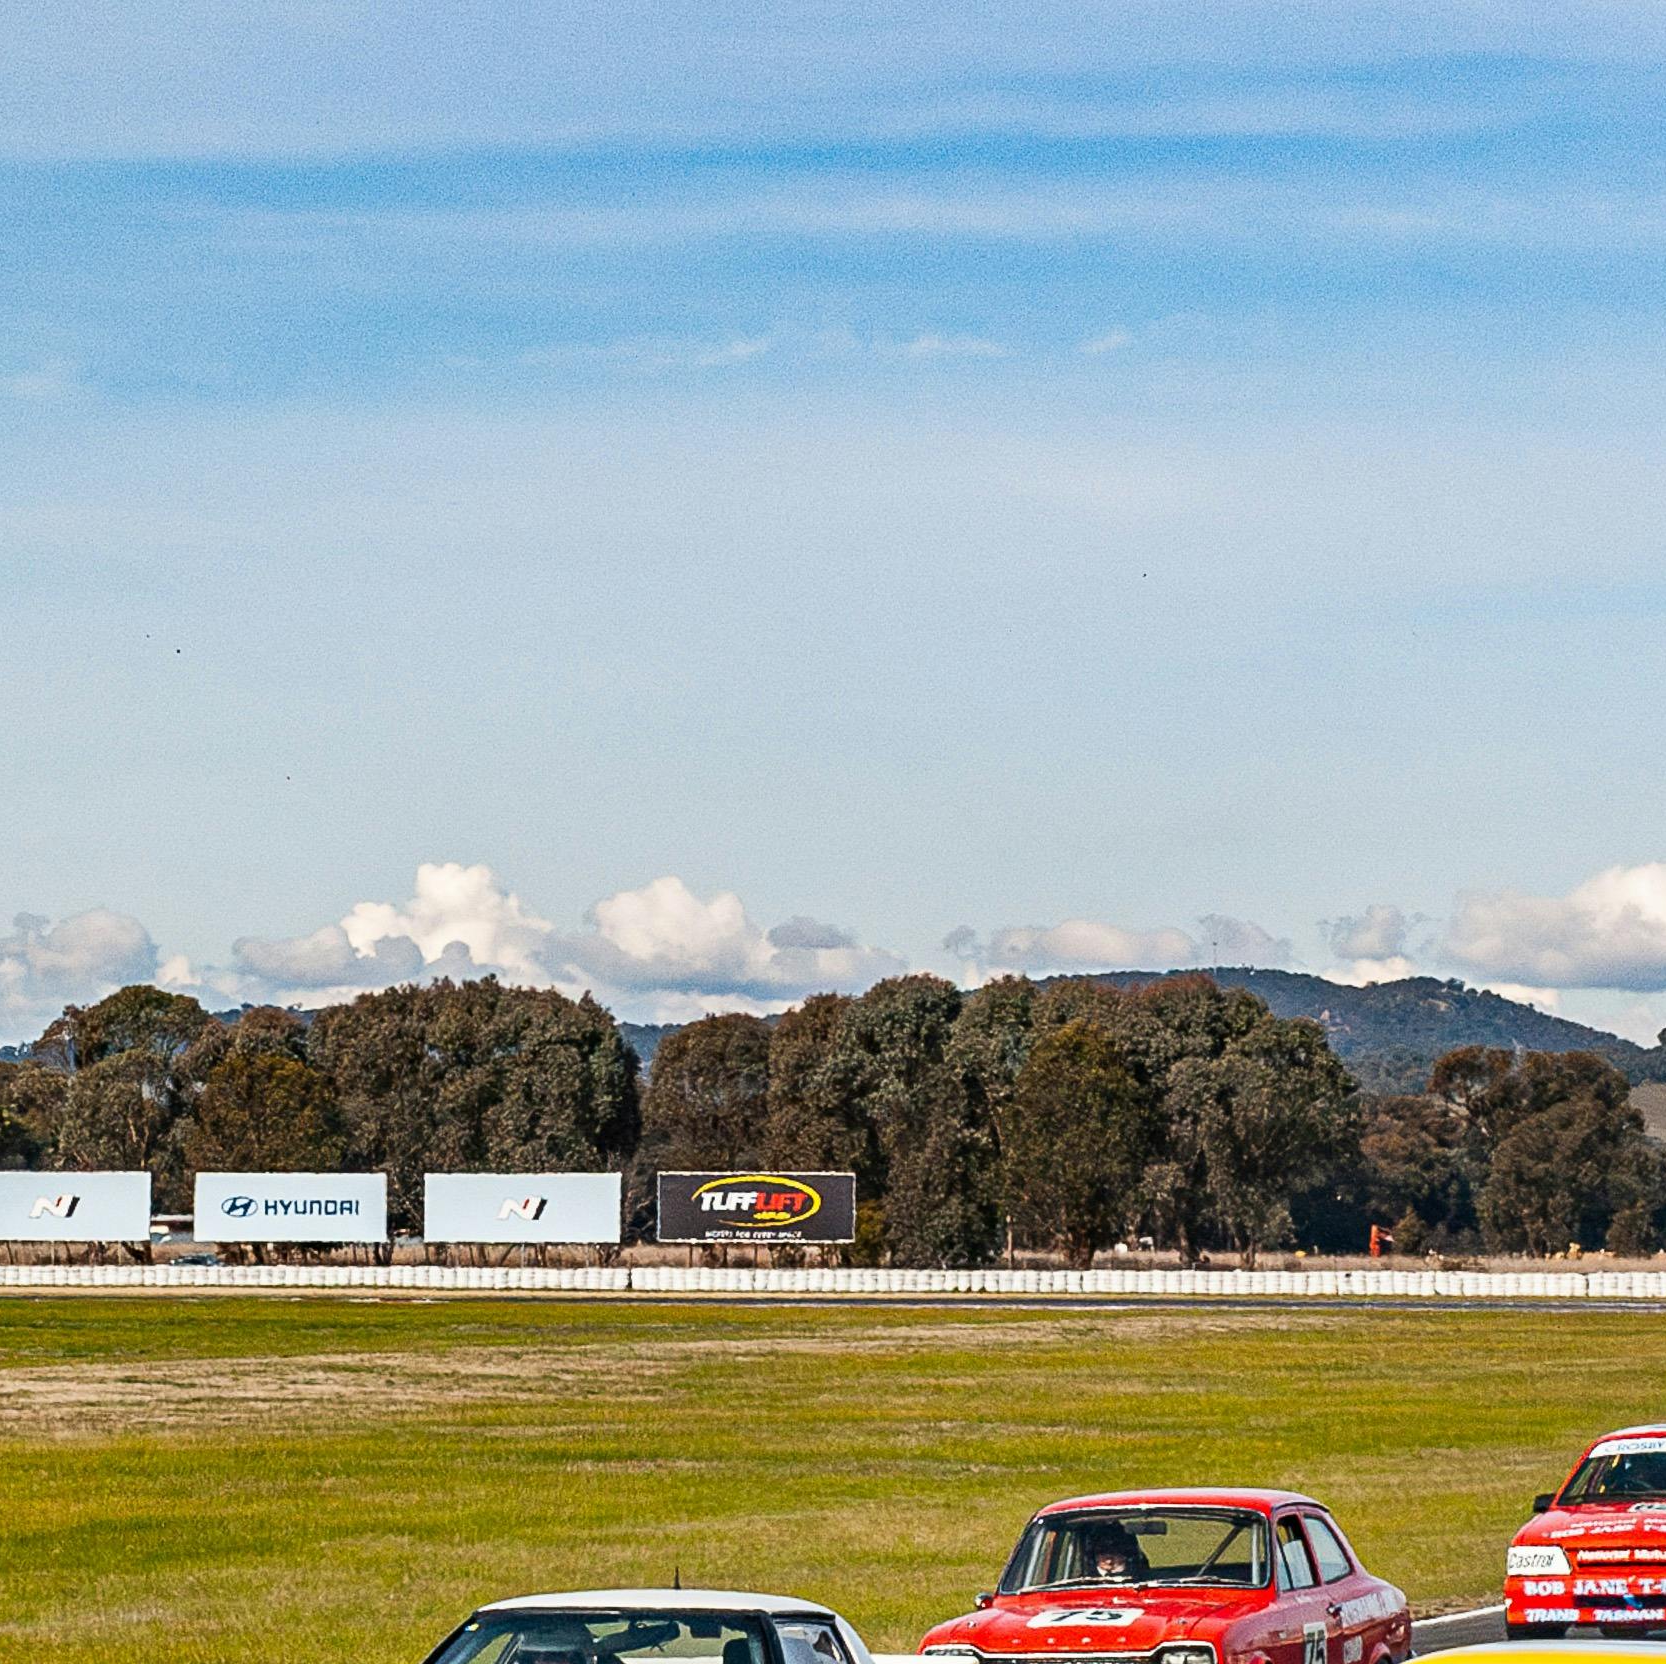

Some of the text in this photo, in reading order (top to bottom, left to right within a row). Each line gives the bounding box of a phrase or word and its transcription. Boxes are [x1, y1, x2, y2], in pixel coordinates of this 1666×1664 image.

[264, 1199, 360, 1216] HYUNDAI
[700, 1191, 808, 1211] TUFFLIFT
[1604, 1440, 1666, 1452] CROSBY
[1508, 1552, 1554, 1570] Castrol
[1523, 1581, 1565, 1596] BOB
[1572, 1579, 1629, 1595] JANE
[1051, 1611, 1123, 1622] 75
[1524, 1609, 1581, 1622] TRANS
